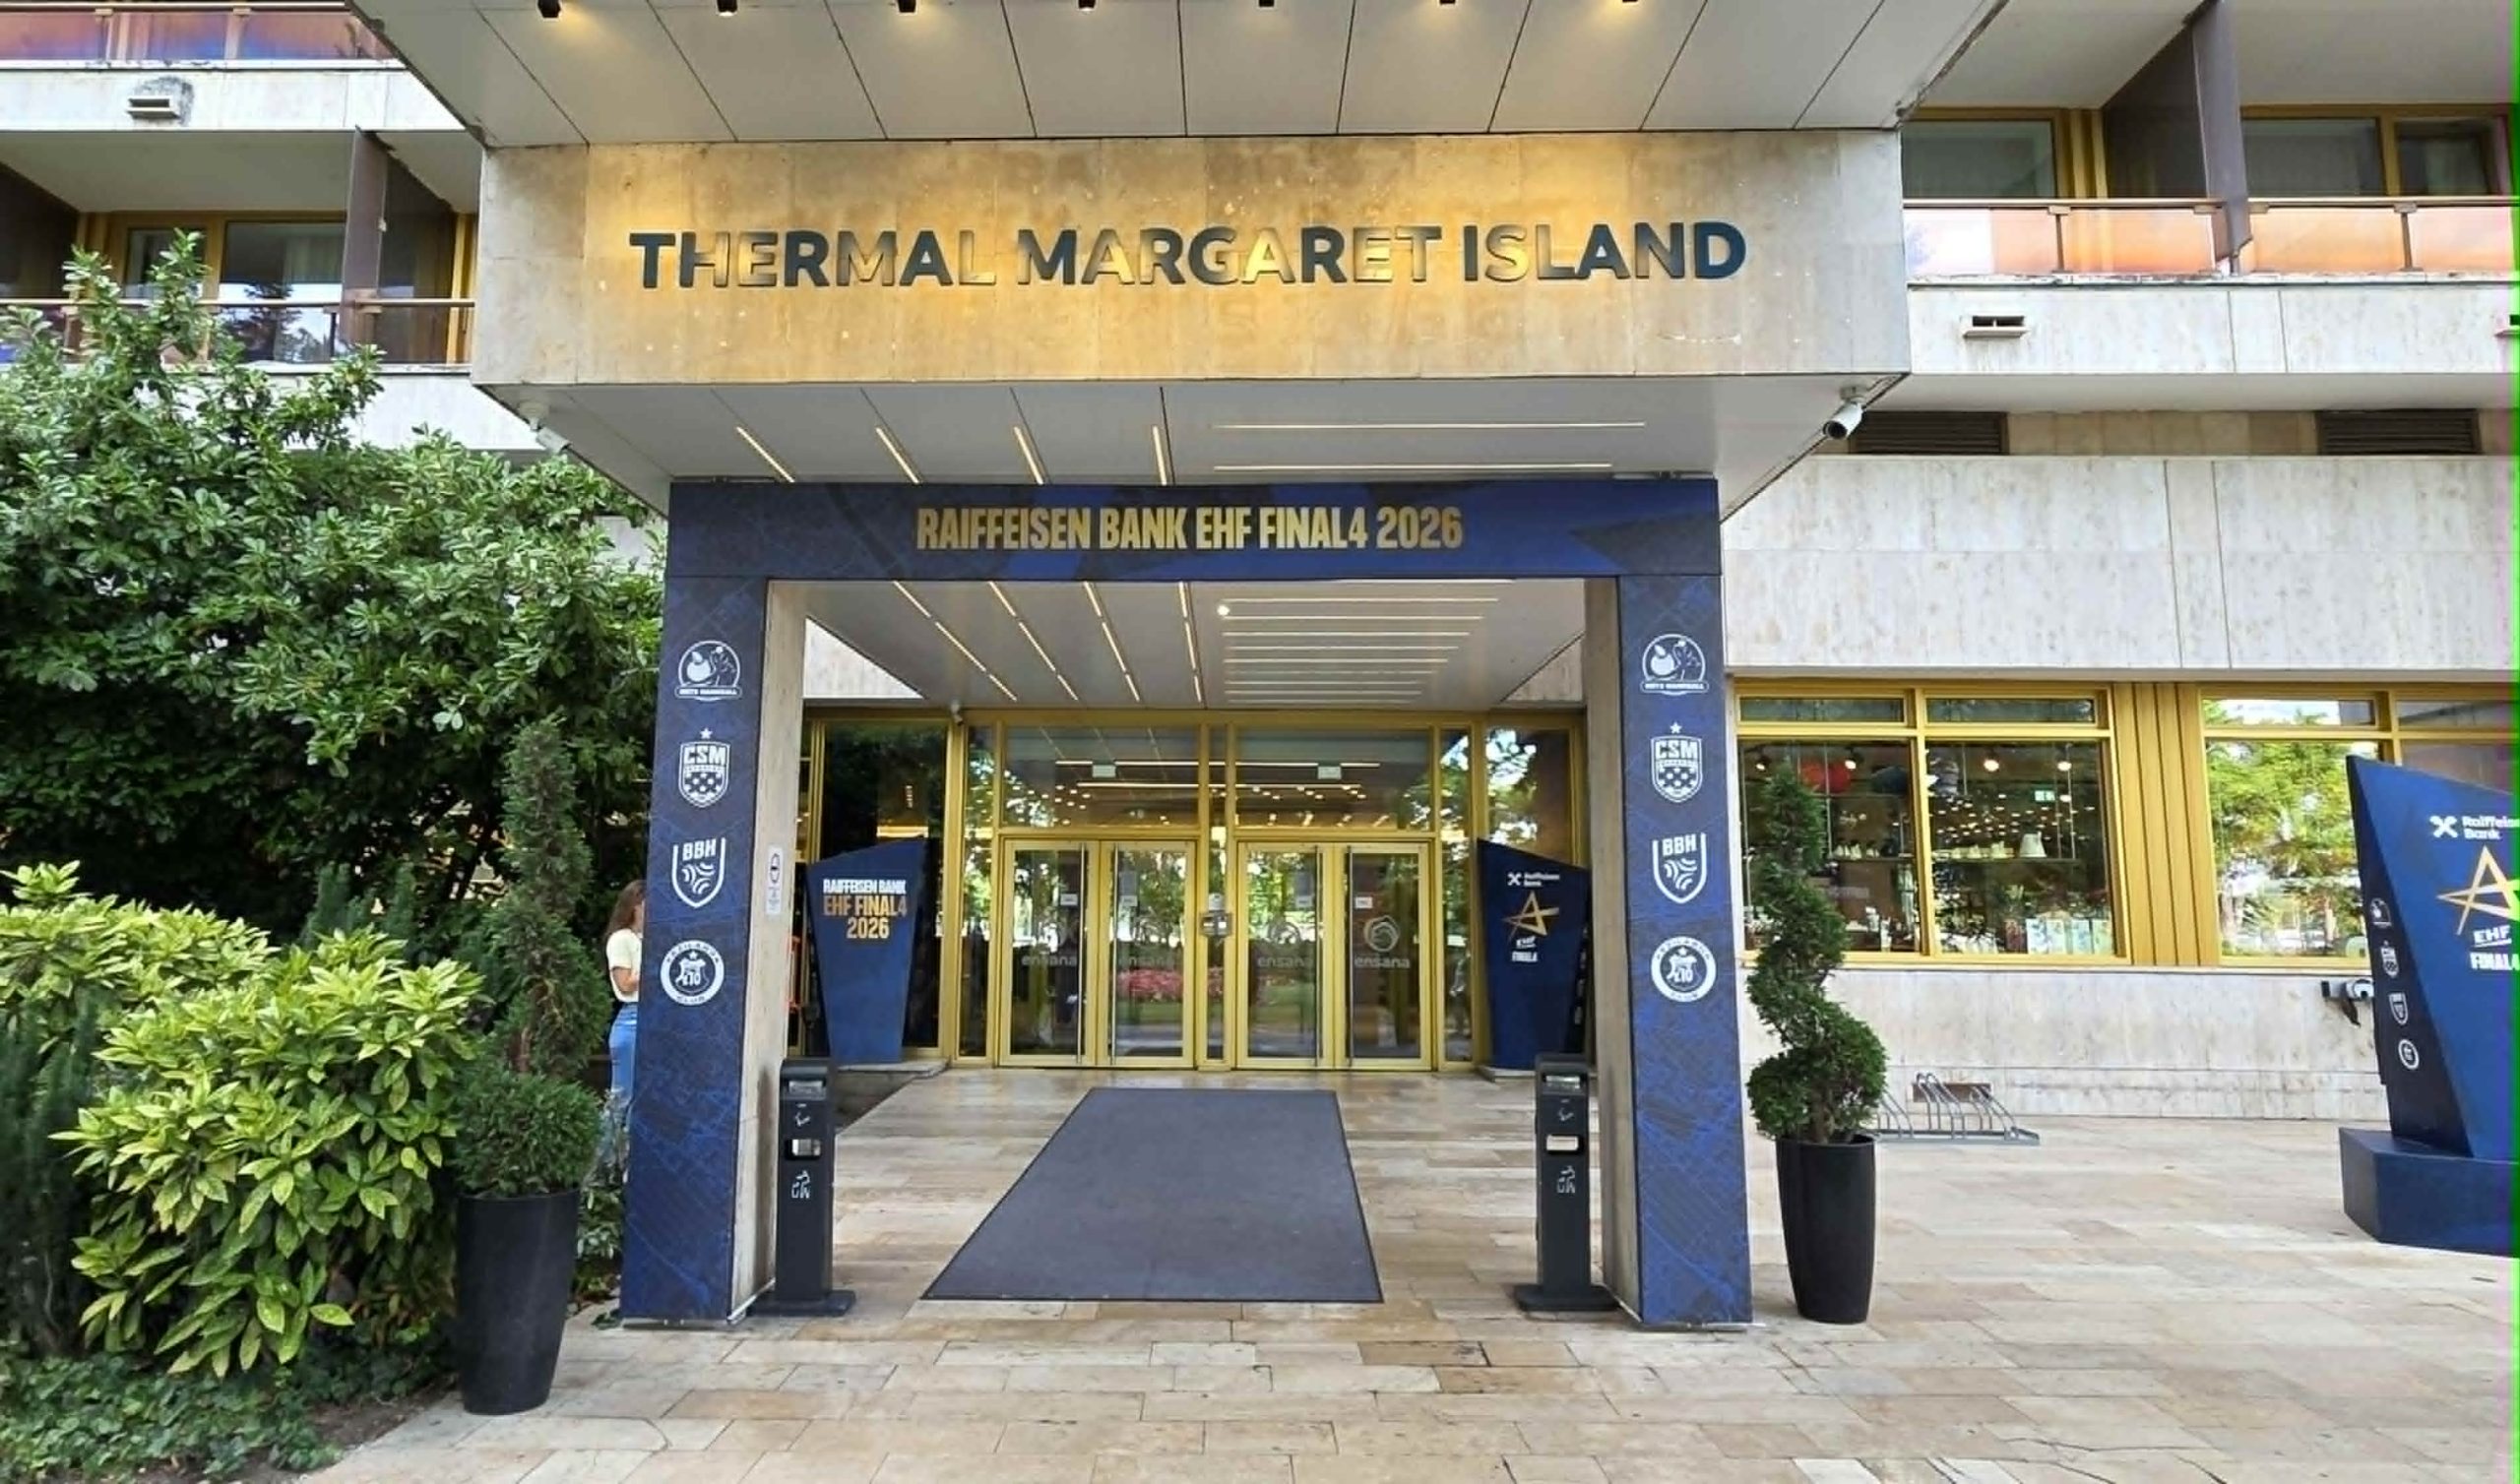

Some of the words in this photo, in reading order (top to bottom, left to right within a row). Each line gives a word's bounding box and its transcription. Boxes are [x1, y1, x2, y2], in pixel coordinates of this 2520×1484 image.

[629, 228, 997, 288] THERMAL
[1016, 224, 1443, 286] MARGARET
[1463, 220, 1748, 283] ISLAND
[916, 507, 1091, 550] RAIFFEISEN
[1099, 507, 1188, 549] BANK
[1195, 507, 1252, 549] EHF
[1258, 506, 1368, 549] FINAL4
[1376, 505, 1464, 549] 2026
[683, 745, 727, 766] CSM
[1655, 739, 1698, 760] CSM
[682, 838, 717, 862] BBH
[1663, 834, 1697, 857] BBH
[823, 879, 877, 895] RAIFFEISEN
[878, 879, 907, 895] BANK
[823, 895, 851, 916] EHF
[854, 895, 908, 917] FINAL4
[847, 917, 890, 939] 2026
[2473, 924, 2511, 944] EHF
[1354, 956, 1411, 969] ensana
